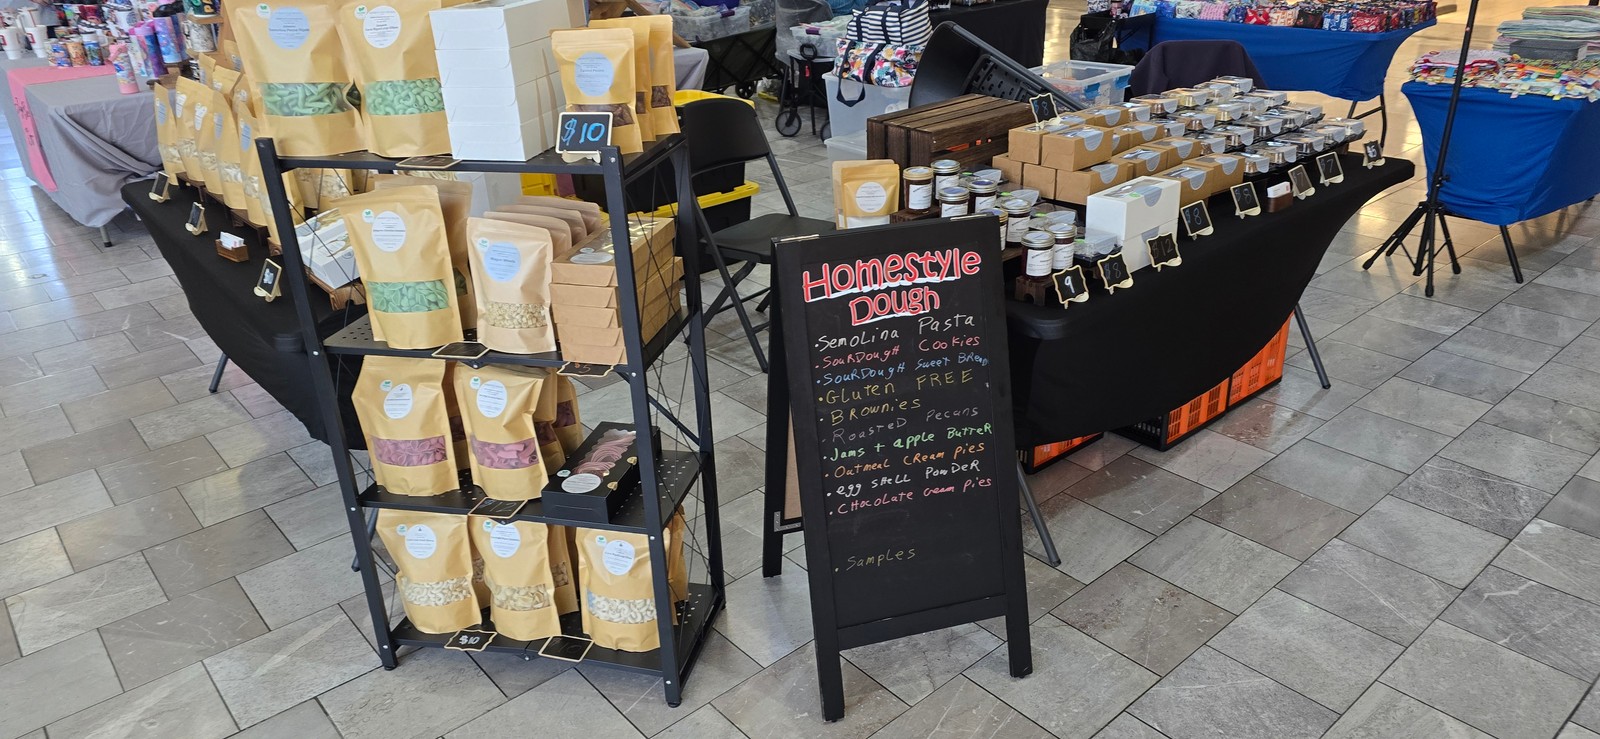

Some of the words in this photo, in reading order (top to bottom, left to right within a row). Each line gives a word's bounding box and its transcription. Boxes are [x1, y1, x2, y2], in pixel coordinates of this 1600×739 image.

[561, 118, 605, 146] $10
[1185, 207, 1202, 226] $8
[802, 248, 981, 302] Homestyle
[1064, 275, 1076, 294] 9
[849, 286, 940, 326] Dough
[918, 313, 975, 335] Pasta
[916, 369, 973, 391] FREE
[830, 447, 866, 462] Jams
[836, 483, 862, 497] egg
[458, 635, 480, 645] $10
